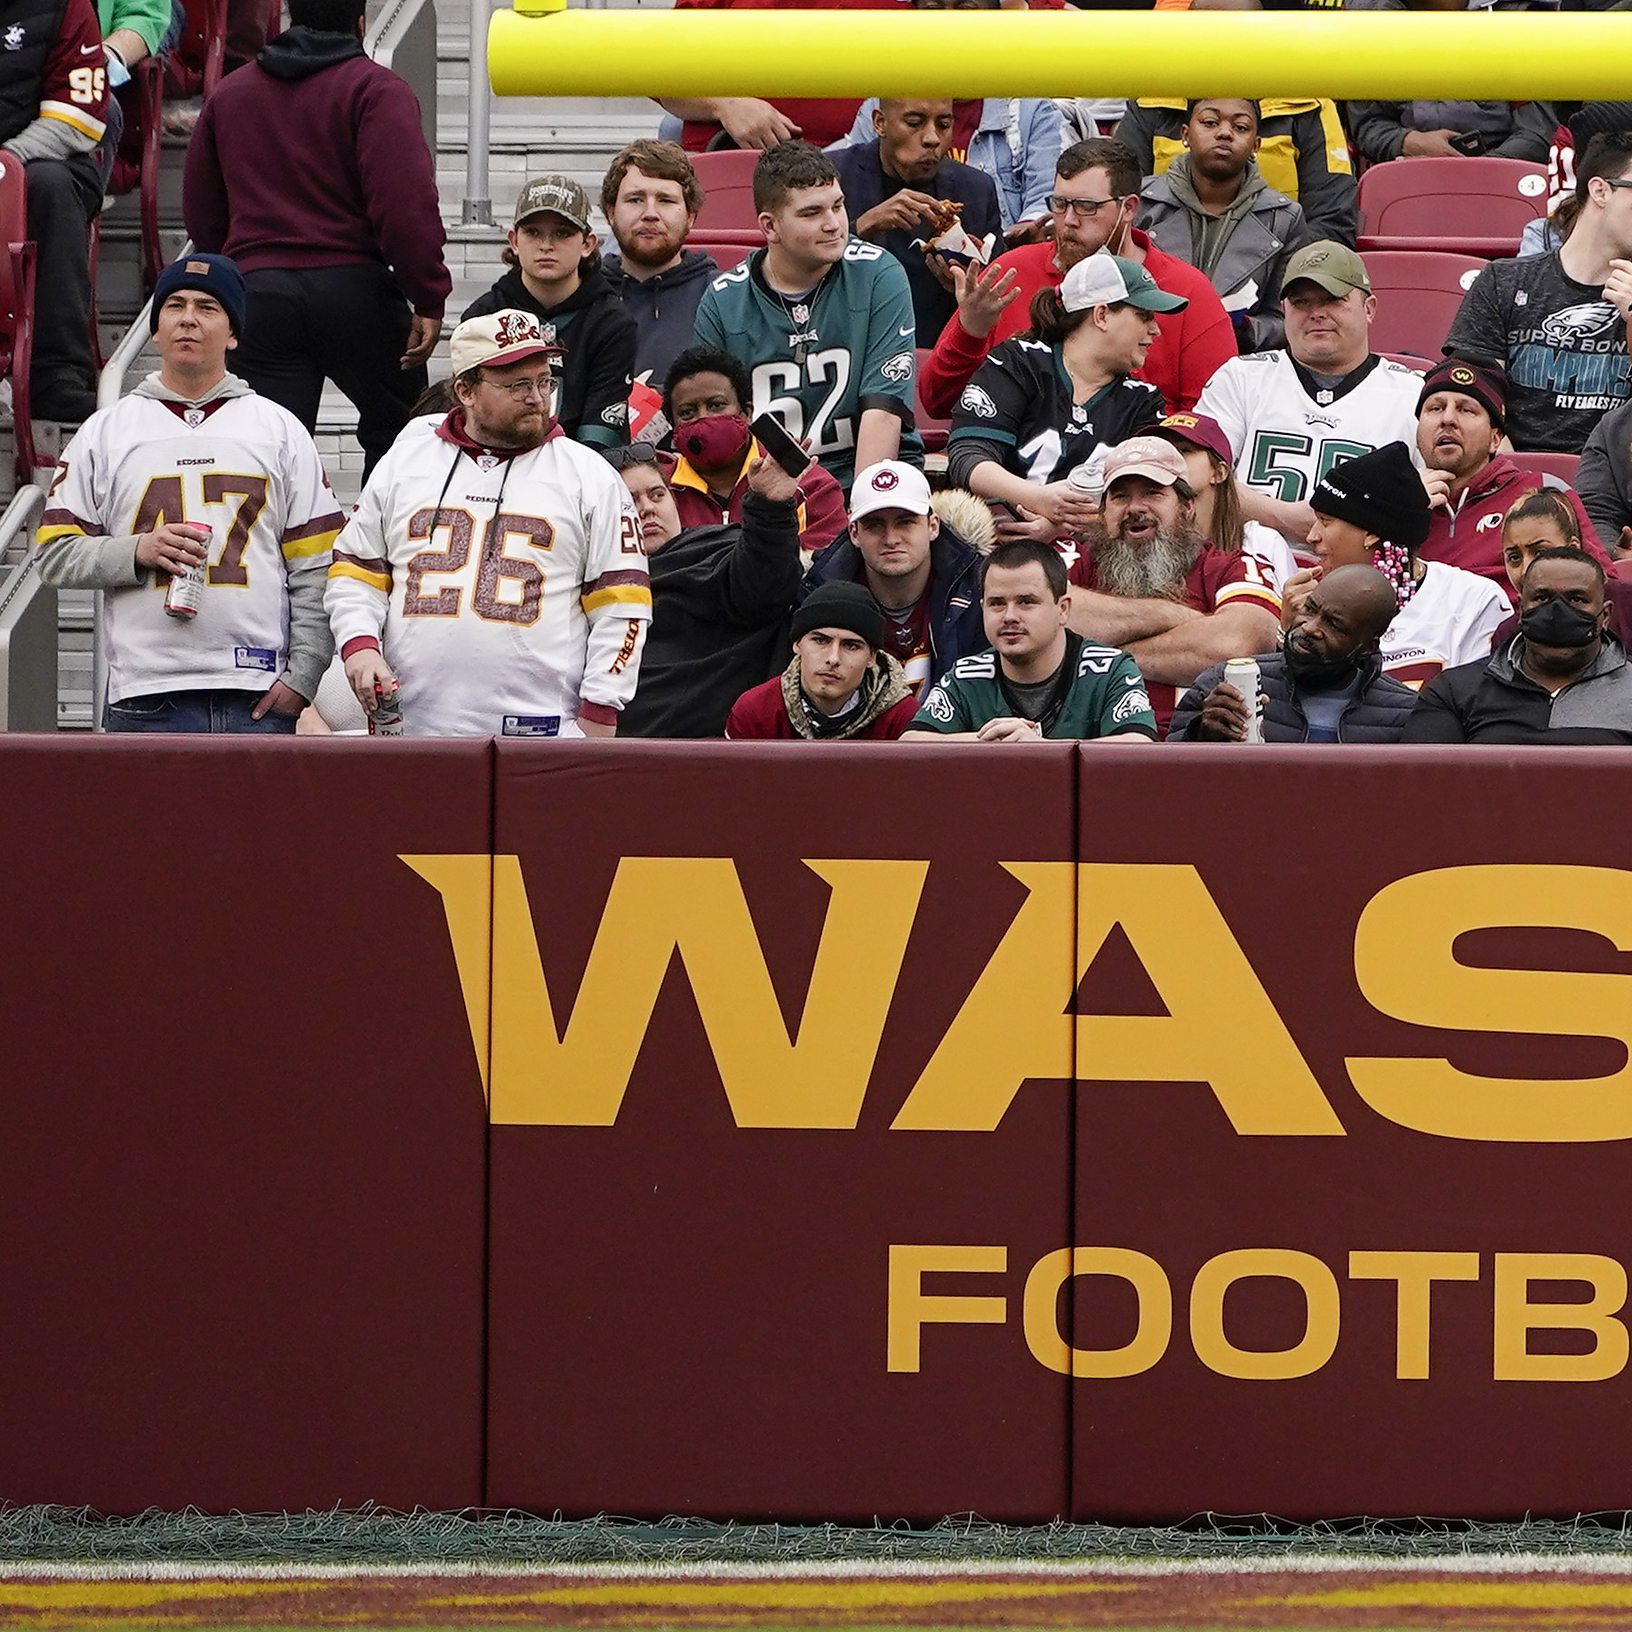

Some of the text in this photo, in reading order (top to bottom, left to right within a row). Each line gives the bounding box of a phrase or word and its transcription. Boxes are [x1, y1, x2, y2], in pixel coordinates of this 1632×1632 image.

[1508, 330, 1566, 351] SUPER
[754, 352, 854, 456] 62
[176, 457, 216, 467] REDSKINS
[135, 472, 270, 589] 47
[403, 507, 557, 627] 26
